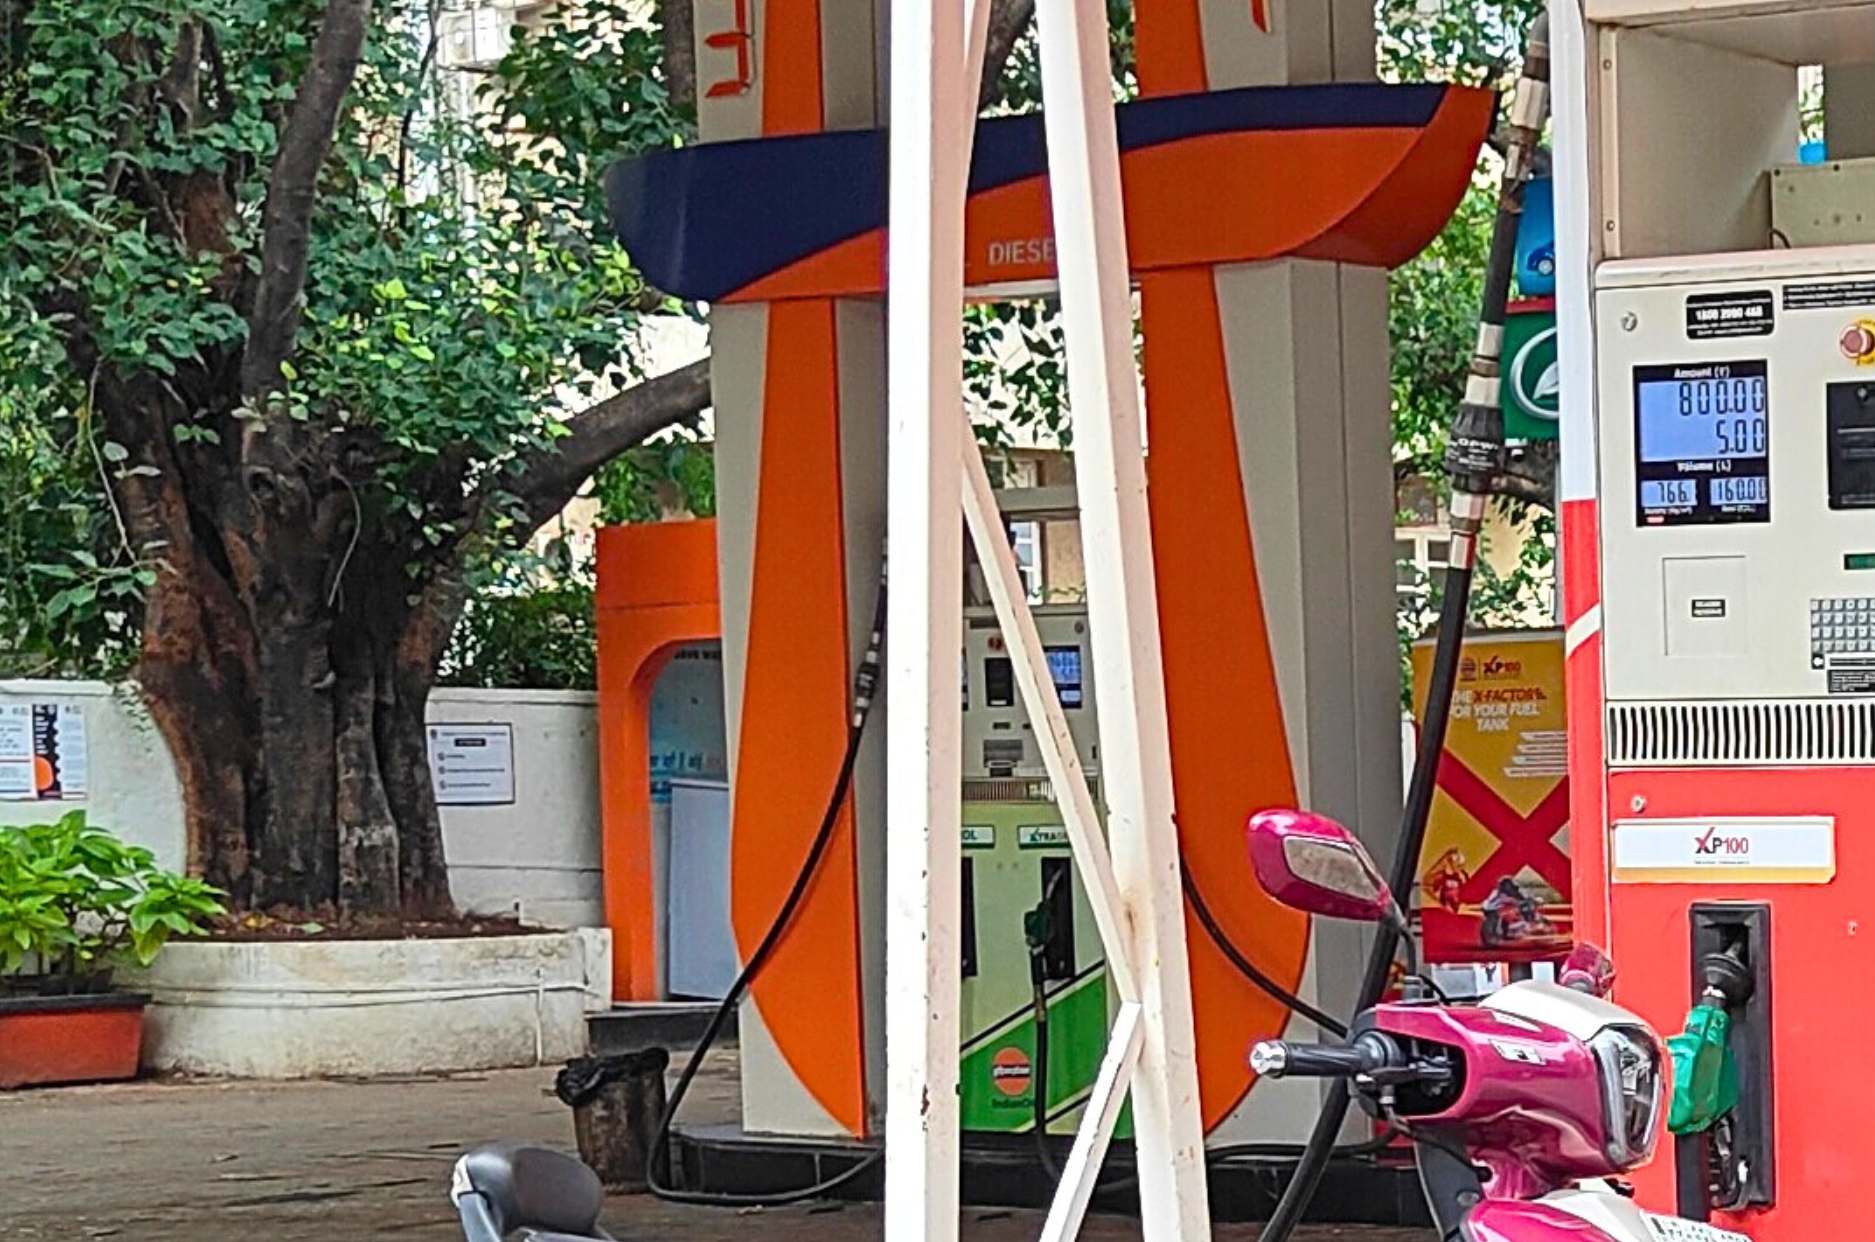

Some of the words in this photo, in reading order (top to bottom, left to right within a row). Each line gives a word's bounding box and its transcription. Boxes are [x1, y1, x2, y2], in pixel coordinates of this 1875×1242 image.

[989, 239, 1056, 265] DIESE
[1679, 379, 1765, 416] 800.00
[1715, 418, 1765, 455] 5.00
[1694, 827, 1749, 855] XP100
